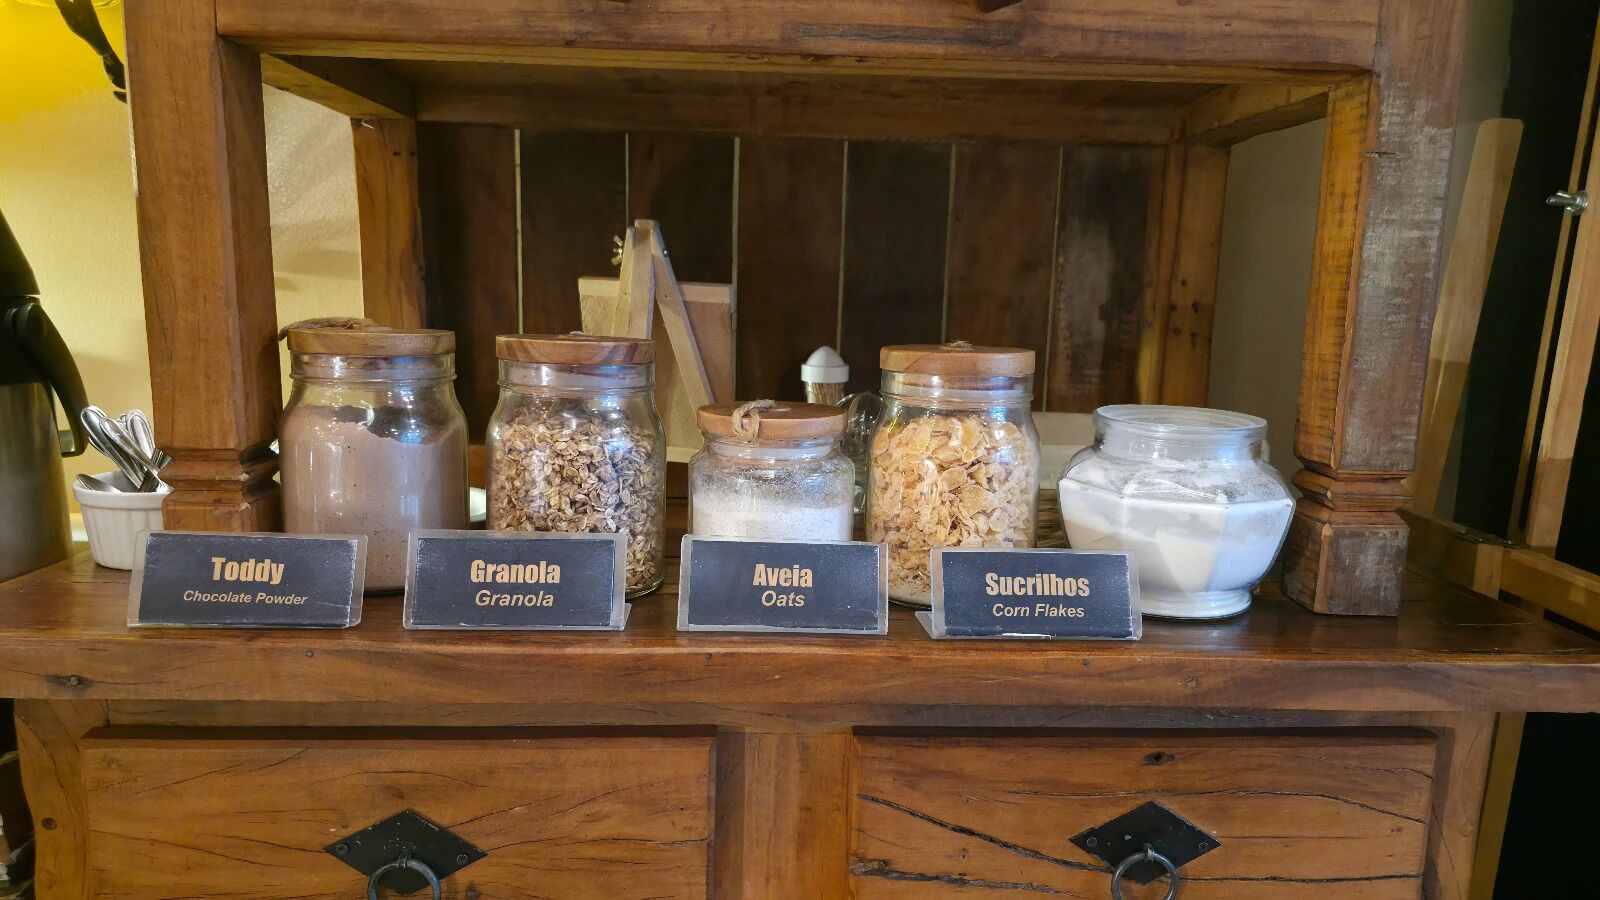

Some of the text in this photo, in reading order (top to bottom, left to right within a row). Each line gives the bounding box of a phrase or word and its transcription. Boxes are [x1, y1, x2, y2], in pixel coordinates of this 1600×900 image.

[211, 556, 285, 585] Toddy
[470, 559, 561, 584] Granola
[752, 563, 813, 588] Aveia
[985, 572, 1091, 597] Sucrilhos
[183, 590, 309, 606] Chocolate Powder
[475, 589, 554, 607] Granola
[761, 590, 806, 607] Oats
[992, 603, 1086, 618] Corn Flakes
